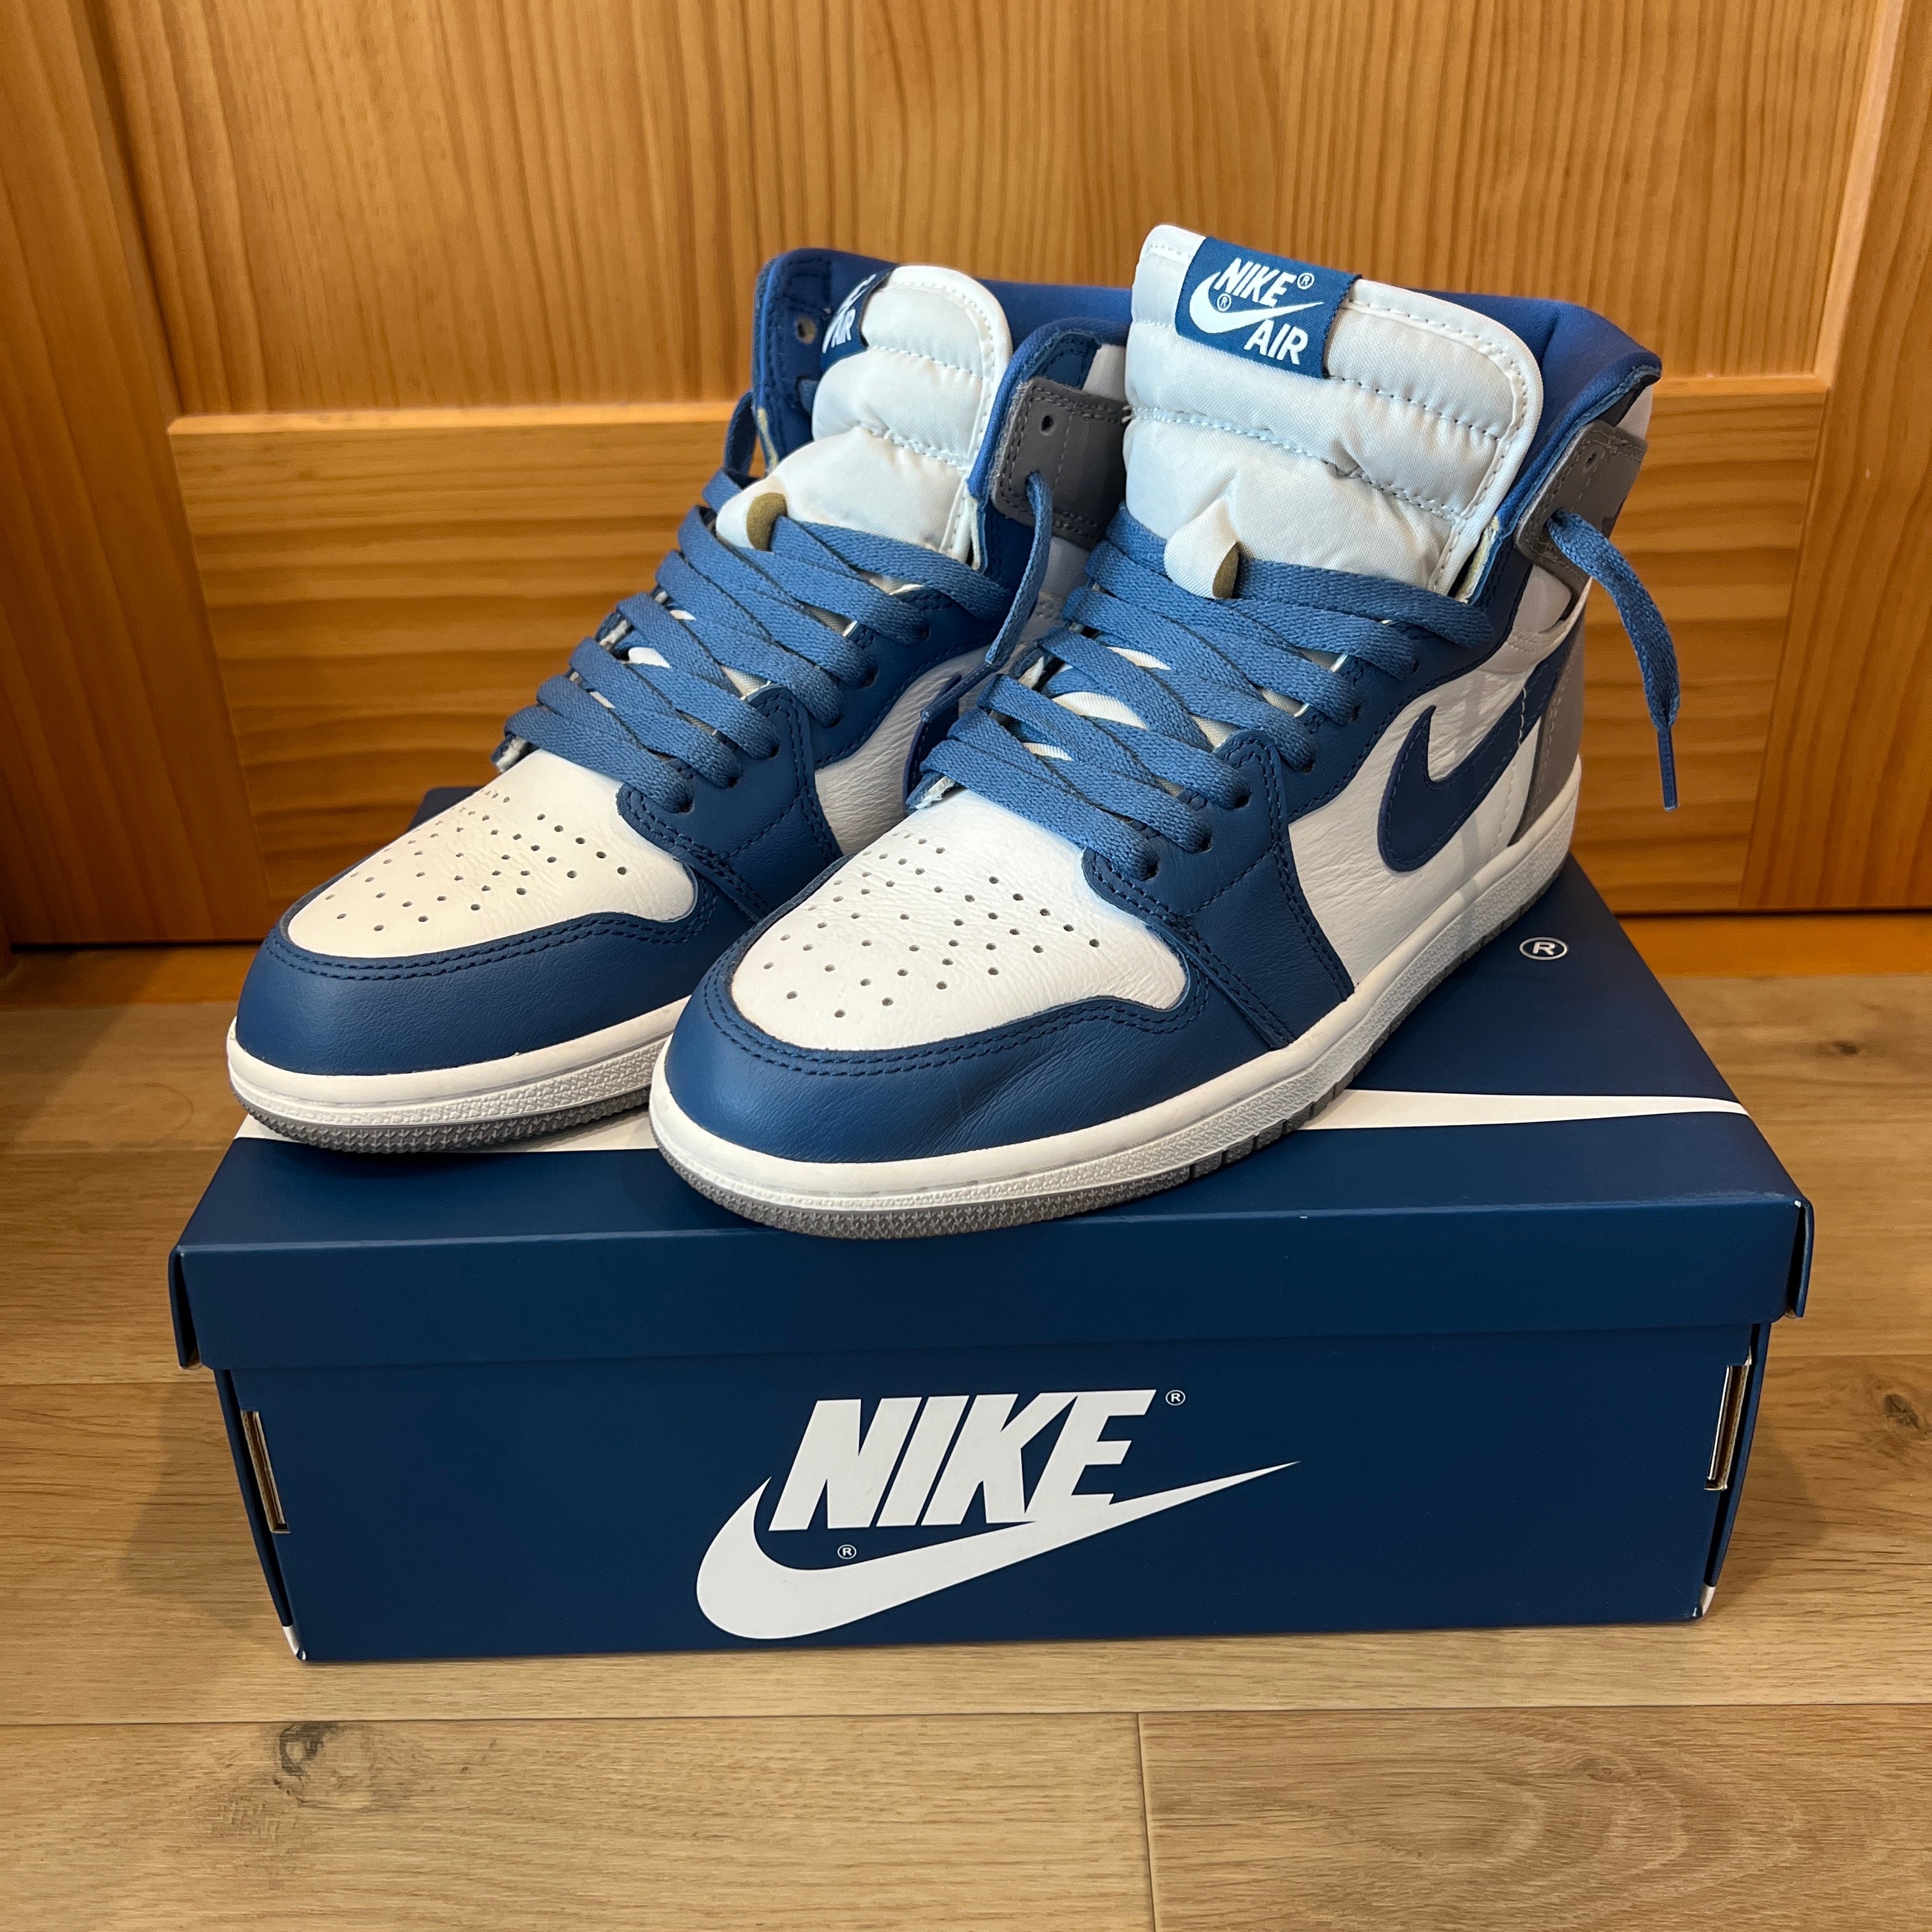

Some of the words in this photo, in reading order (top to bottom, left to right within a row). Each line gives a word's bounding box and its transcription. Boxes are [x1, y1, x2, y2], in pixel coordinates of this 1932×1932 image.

[1213, 257, 1297, 307] NIKE
[1243, 319, 1308, 365] AIR
[768, 1389, 1156, 1531] NIKE
